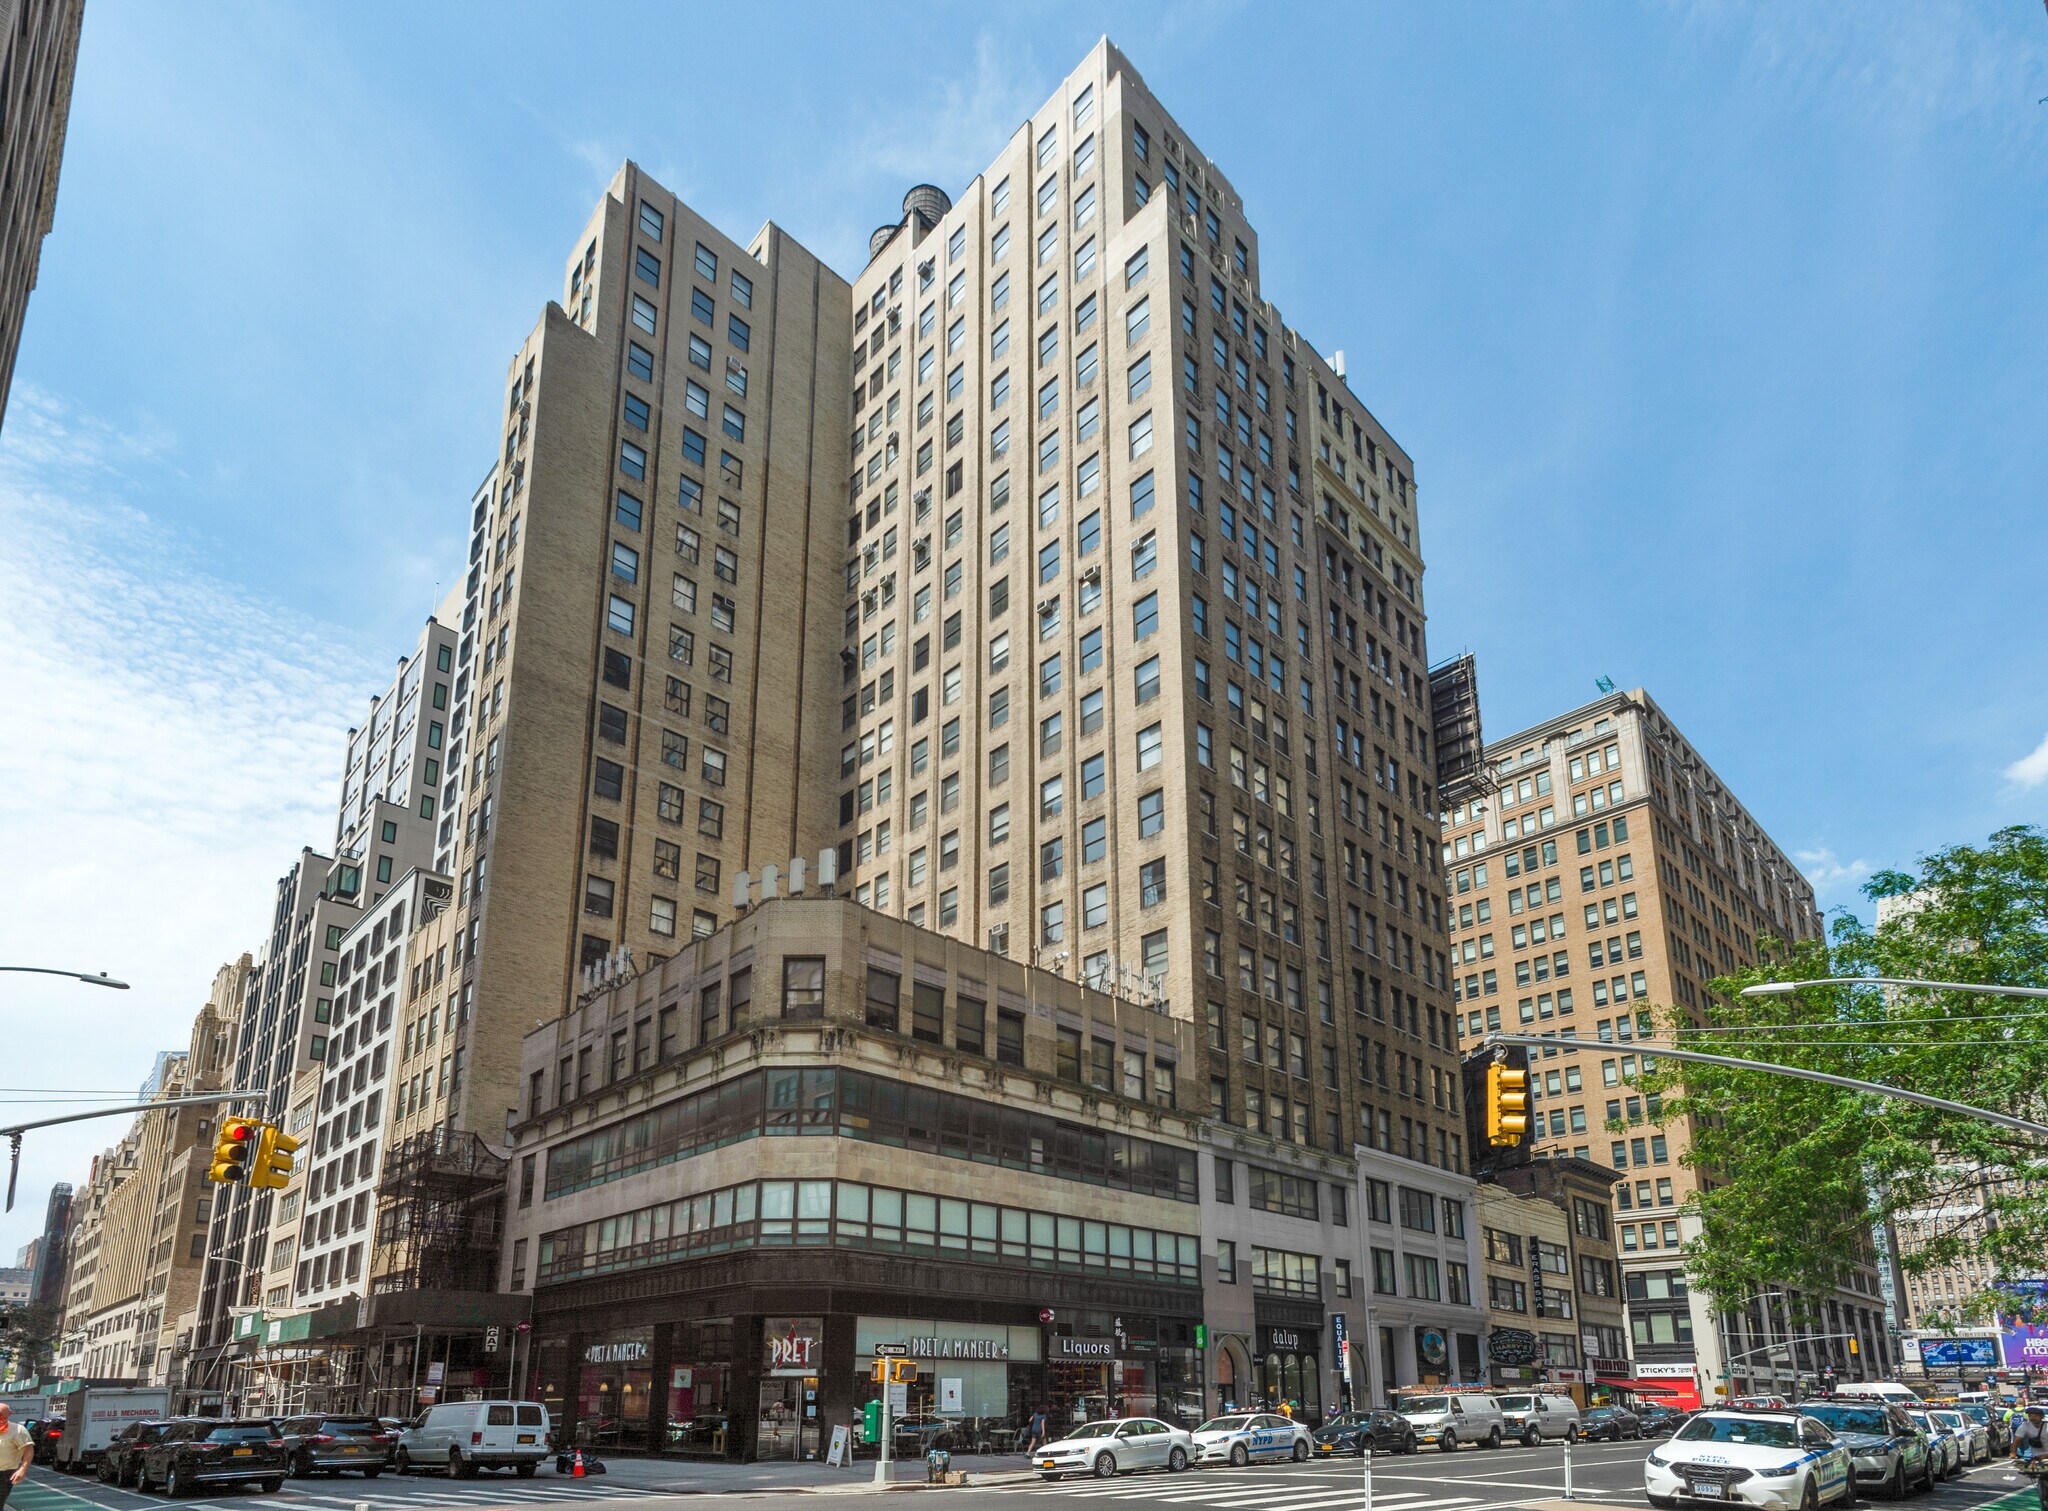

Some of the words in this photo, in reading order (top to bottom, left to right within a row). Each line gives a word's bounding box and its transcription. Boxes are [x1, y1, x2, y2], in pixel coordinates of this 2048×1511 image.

[1532, 1254, 1540, 1287] ERASE
[1535, 1290, 1543, 1308] SPA
[772, 1336, 813, 1362] PRET
[912, 1338, 938, 1356] PRET
[942, 1339, 949, 1356] A
[954, 1340, 998, 1358] MANGER
[1063, 1340, 1110, 1356] Liquors
[1272, 1328, 1298, 1350] dalup
[1336, 1316, 1344, 1368] EQUALITY
[591, 1345, 605, 1363] PRET
[612, 1342, 642, 1361] MANGER
[2023, 1346, 2048, 1354] ma
[1252, 1436, 1273, 1446] NYPD
